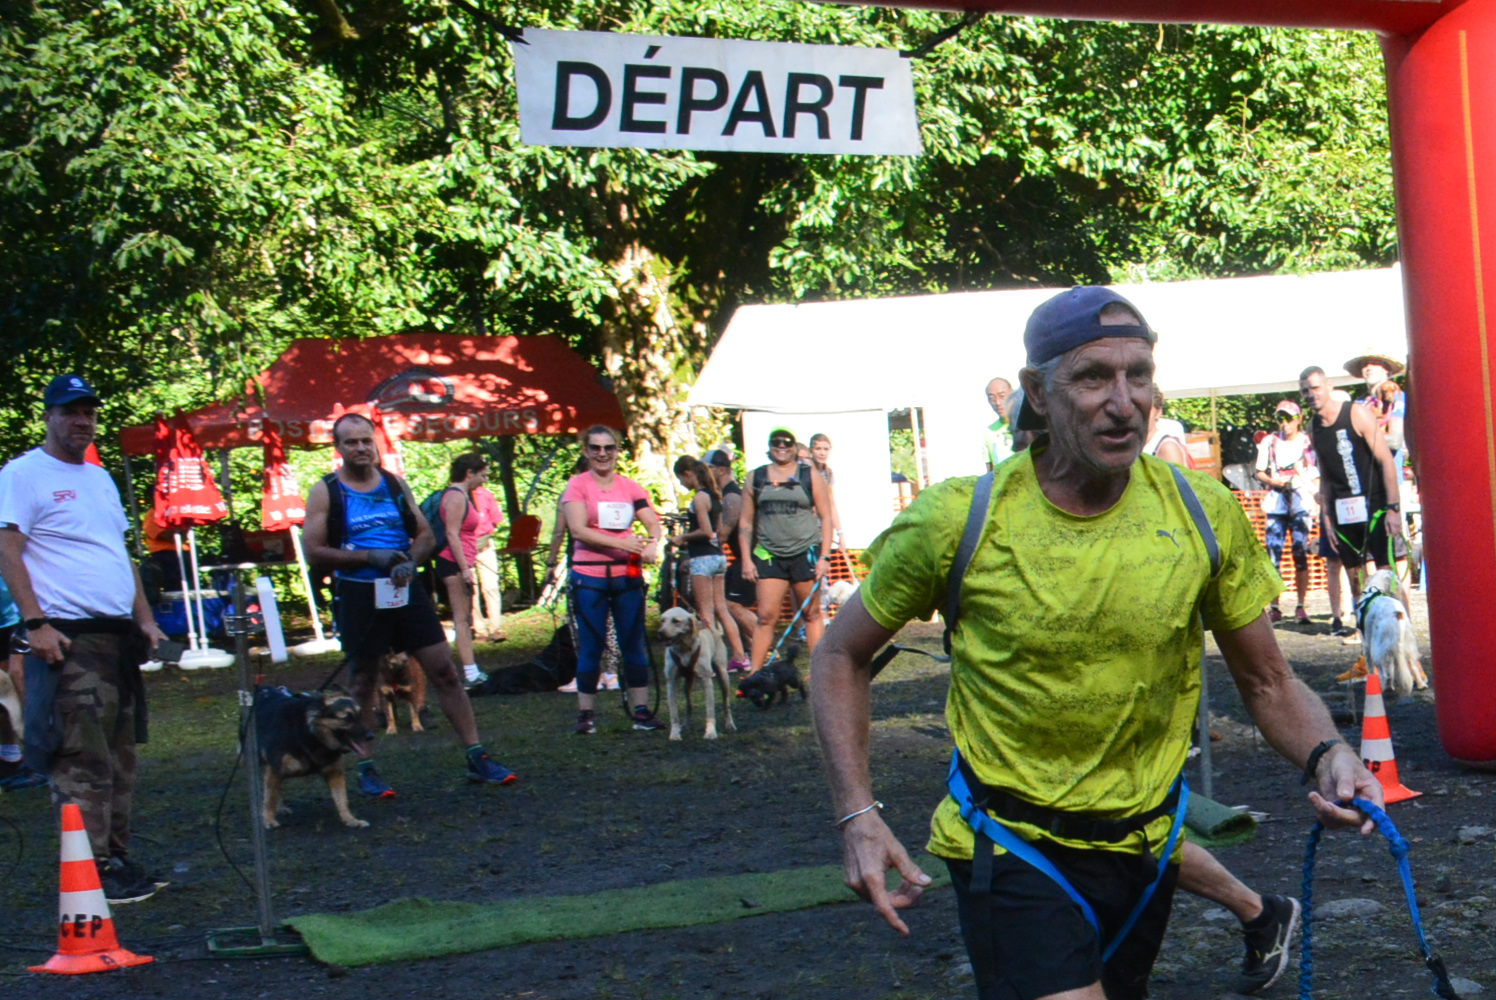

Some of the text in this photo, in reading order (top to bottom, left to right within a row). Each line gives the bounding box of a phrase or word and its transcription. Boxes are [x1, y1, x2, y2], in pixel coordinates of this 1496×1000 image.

[551, 45, 885, 141] DÉPART
[407, 410, 539, 435] SECOURS
[614, 510, 621, 521] 3
[1346, 506, 1355, 516] 11
